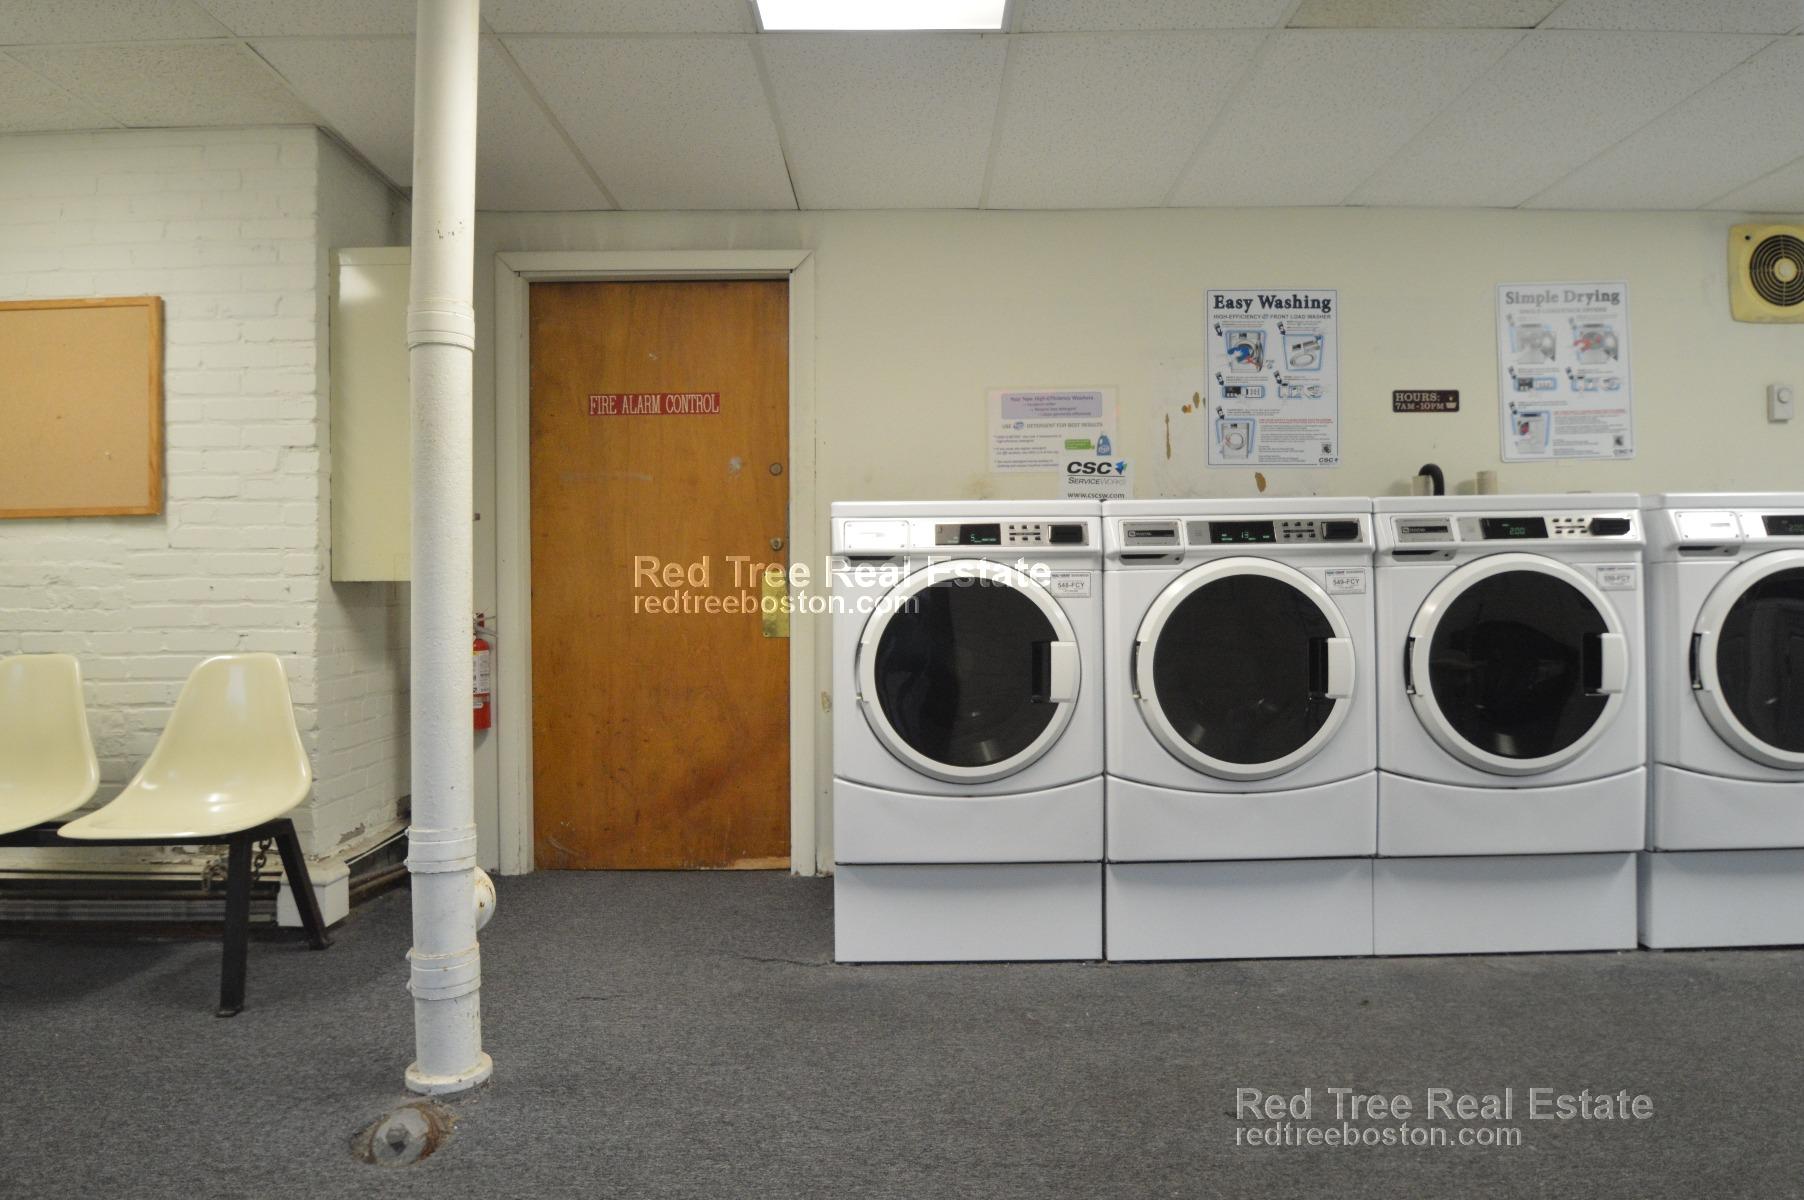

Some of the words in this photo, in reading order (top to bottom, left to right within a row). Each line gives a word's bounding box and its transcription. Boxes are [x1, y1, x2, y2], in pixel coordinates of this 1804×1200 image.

[1213, 294, 1253, 313] Easy
[1257, 293, 1332, 313] Washing
[1505, 289, 1559, 307] Simple
[1563, 289, 1621, 306] Drying
[590, 395, 617, 415] FIRE
[622, 394, 661, 414] ALARM
[665, 393, 720, 413] CONTROL
[1395, 392, 1440, 402] HOURS:
[1067, 461, 1113, 475] CSC
